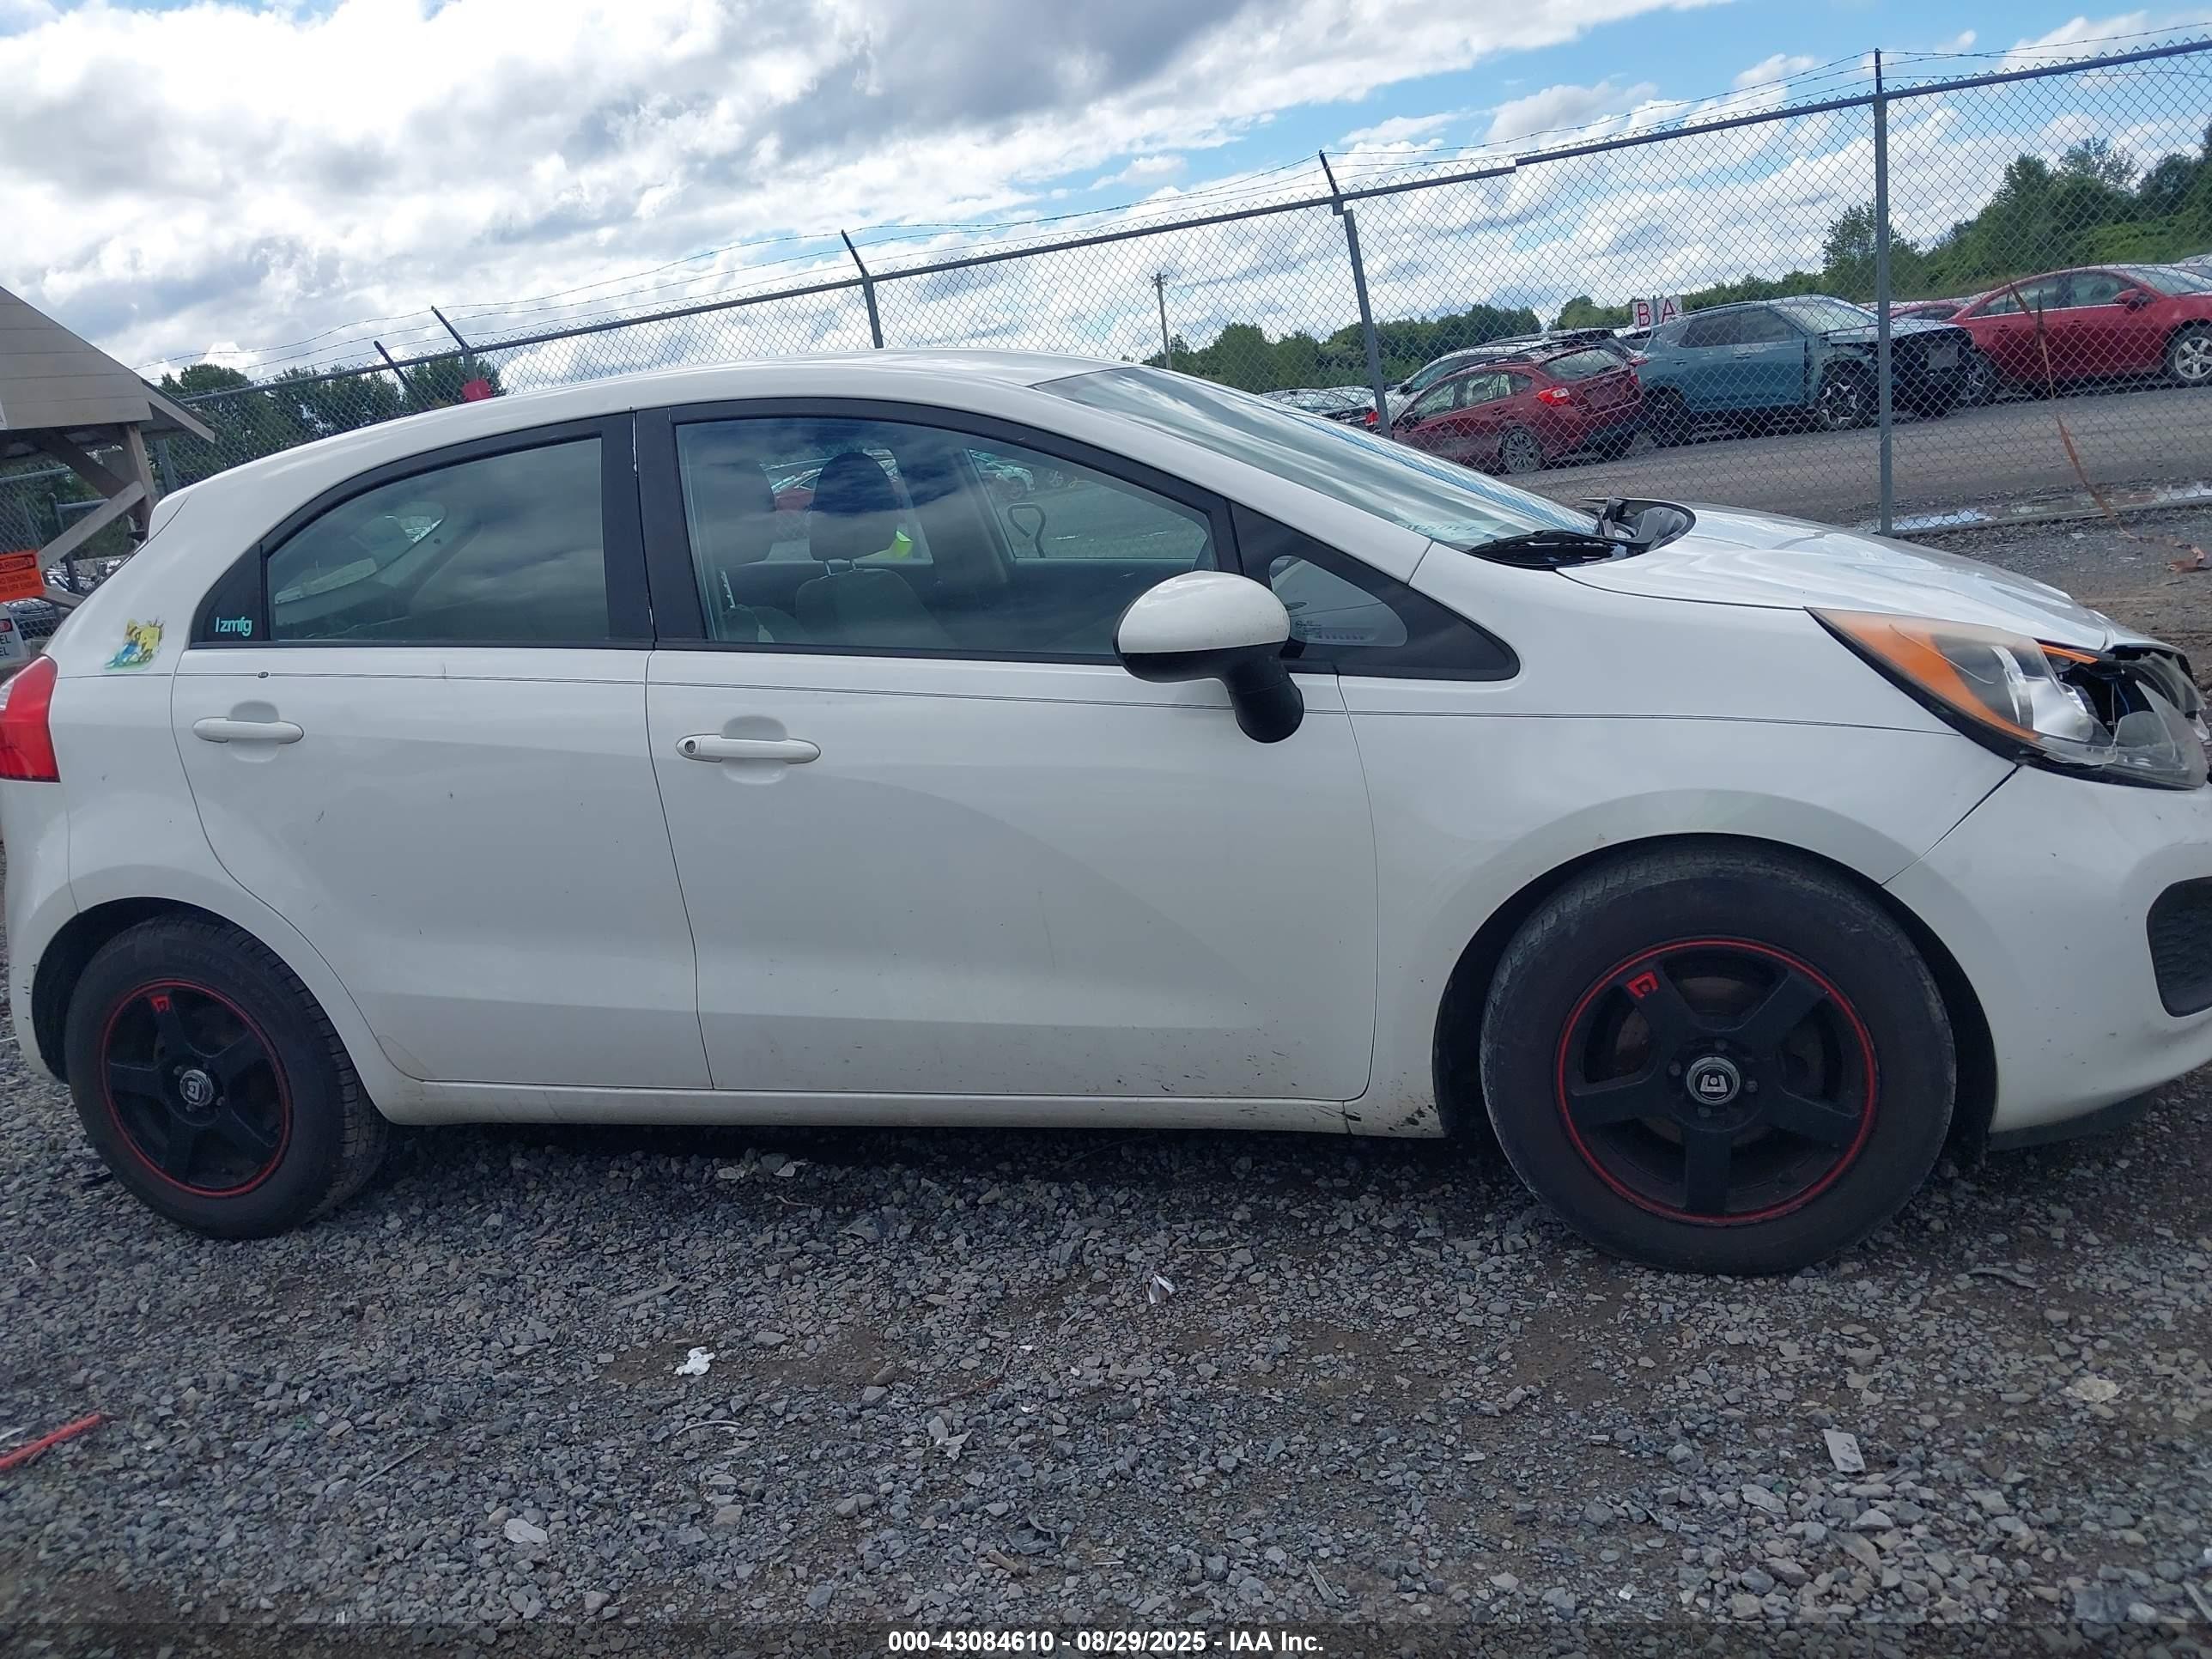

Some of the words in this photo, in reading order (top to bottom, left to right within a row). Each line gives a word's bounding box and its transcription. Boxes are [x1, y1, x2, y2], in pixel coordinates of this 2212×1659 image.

[1638, 302, 1651, 327] B
[1661, 299, 1676, 324] A
[0, 557, 32, 572] ARNING
[0, 634, 12, 645] EL
[0, 646, 10, 657] EL
